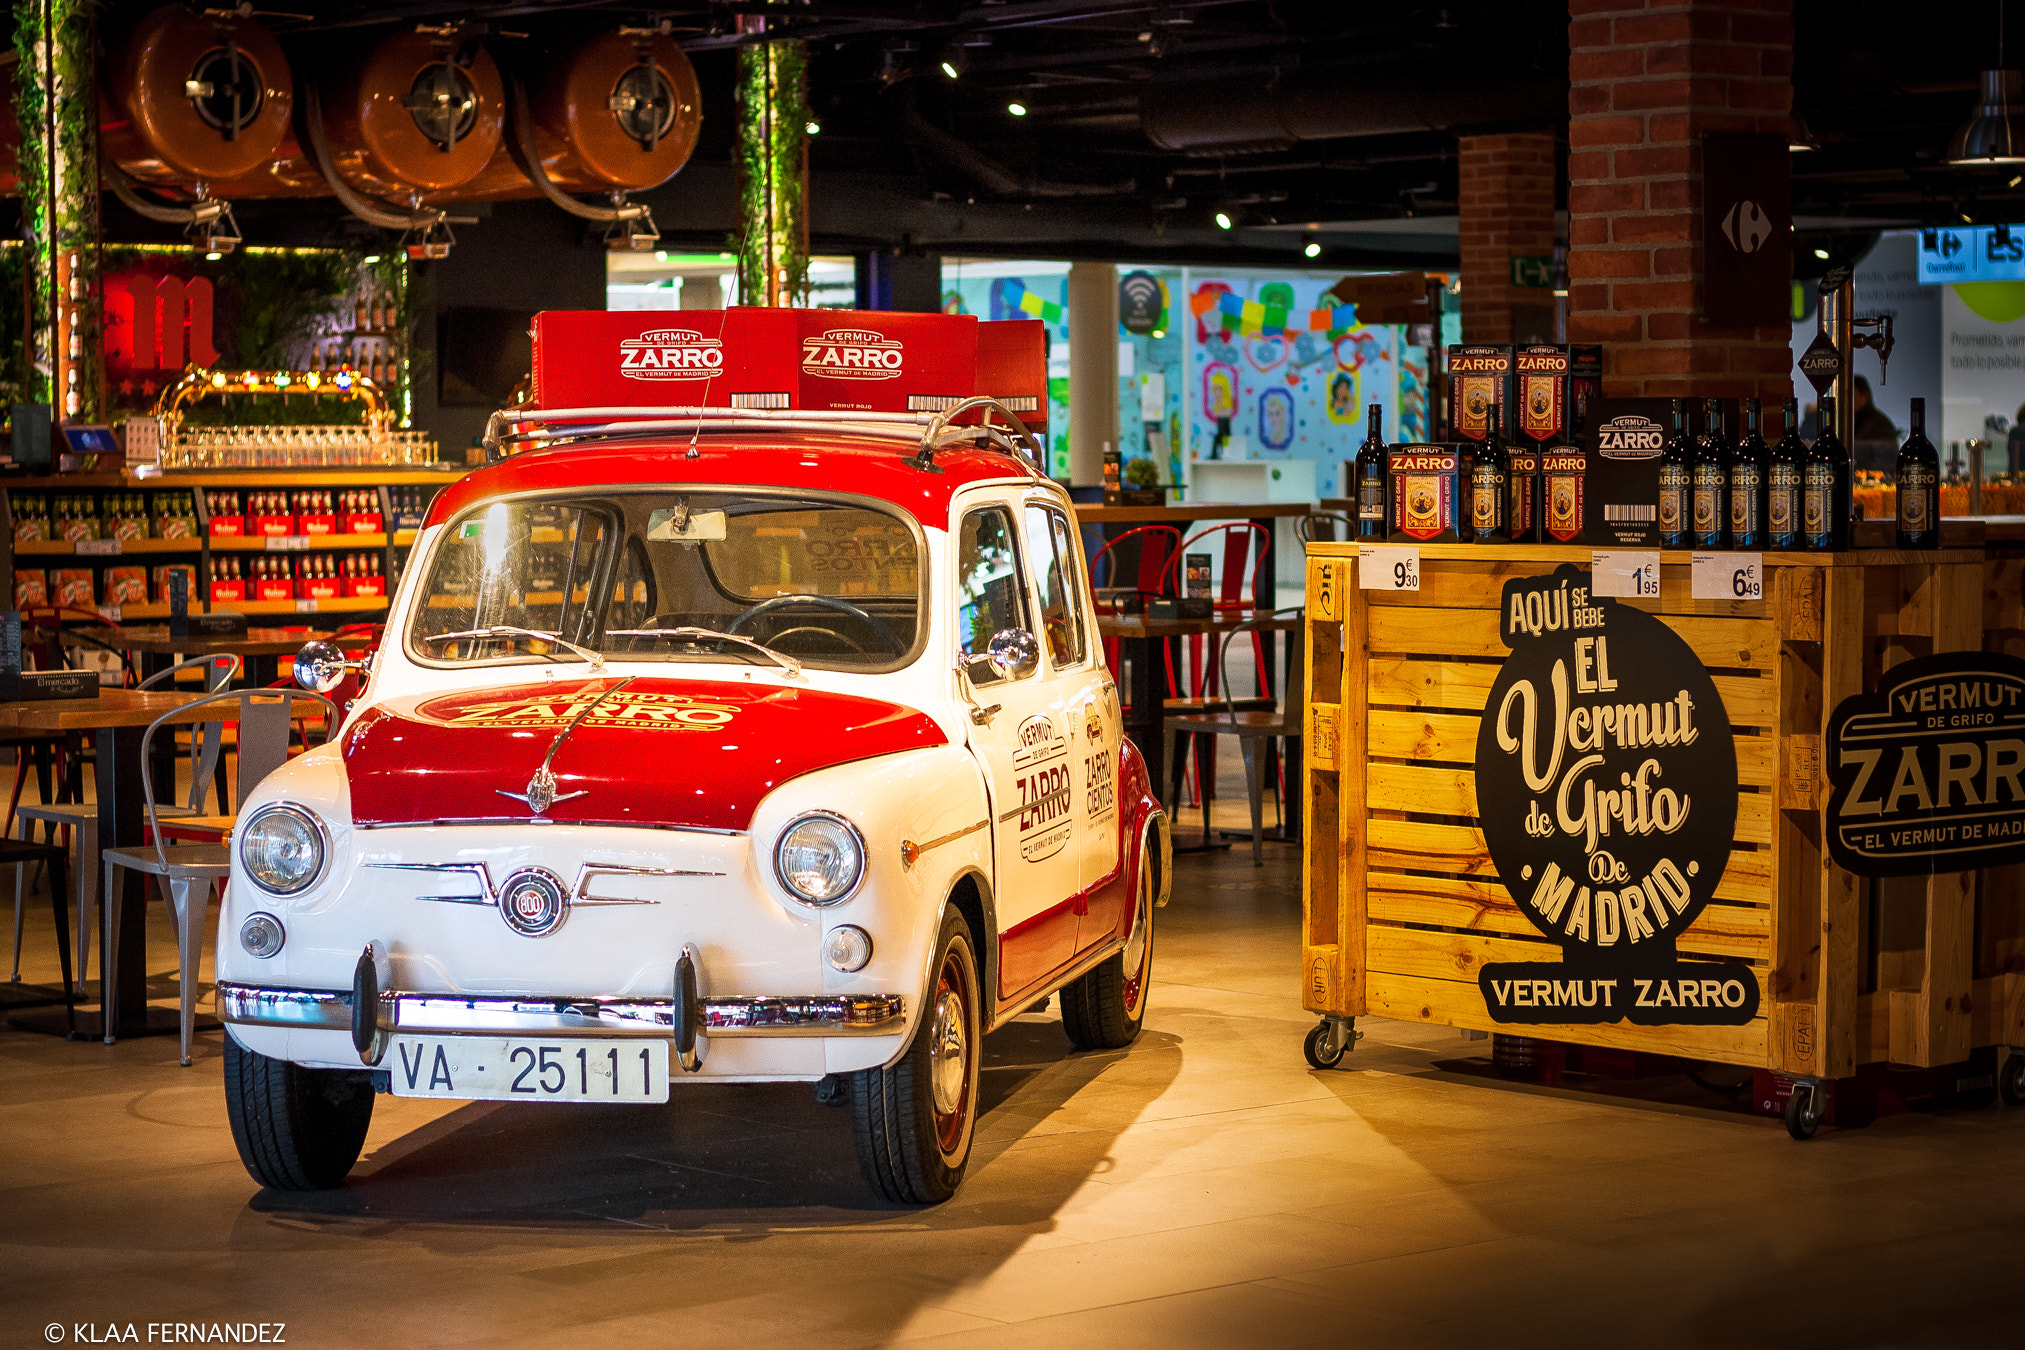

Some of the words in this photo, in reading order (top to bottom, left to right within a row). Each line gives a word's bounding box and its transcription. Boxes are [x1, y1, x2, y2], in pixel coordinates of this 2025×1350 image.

[644, 332, 698, 341] VERMUT
[828, 332, 880, 342] VERMUT
[620, 348, 723, 368] ZARRO
[802, 346, 903, 369] ZARRO
[1452, 358, 1508, 370] ZARRO
[1518, 358, 1567, 370] ZARRO
[1803, 358, 1839, 369] ZARRO
[1614, 418, 1648, 426] VERMUT
[1600, 432, 1663, 449] ZARRO
[1392, 458, 1455, 470] ZARRO
[1543, 458, 1586, 470] ZARRO
[1472, 474, 1504, 484] ARRO
[1659, 475, 1690, 485] ARRO
[1694, 475, 1725, 485] ARRO
[1768, 475, 1801, 485] ARRO
[1394, 562, 1406, 587] 9
[1406, 558, 1412, 571] €
[1644, 564, 1652, 577] €
[1746, 565, 1754, 578] €
[1406, 575, 1418, 587] 30
[1632, 568, 1641, 594] 1
[1644, 581, 1658, 594] 95
[1733, 568, 1746, 596] 6
[1746, 582, 1760, 596] 49
[1509, 580, 1570, 637] AQUÍ
[1572, 586, 1589, 608] SE
[1572, 607, 1606, 630] BEBE
[1574, 636, 1618, 694] EL
[1898, 682, 2022, 712] VERMUT
[456, 702, 734, 724] ZARRO
[1927, 716, 1945, 728] DE
[1951, 713, 1994, 726] GRIFO
[1020, 722, 1053, 747] VERMUT
[1496, 658, 1699, 794] Vermut
[1085, 749, 1111, 789] ZARRO
[1839, 738, 2025, 816] ZARR
[1016, 763, 1070, 832] ZARRO
[1087, 781, 1113, 815] CIENTOS
[1525, 800, 1554, 838] de
[1557, 754, 1691, 855] Grifo
[1865, 834, 1885, 848] EL
[1891, 827, 1957, 846] VERMUT
[1962, 824, 1982, 840] DE
[1988, 821, 2025, 838] MAD
[1588, 851, 1629, 884] De
[520, 896, 540, 913] 800
[1530, 858, 1692, 947] MADRID
[1491, 980, 1618, 1008] VERMUT
[1634, 979, 1746, 1008] ZARRO
[399, 1042, 454, 1090] VA
[510, 1046, 650, 1096] 25111
